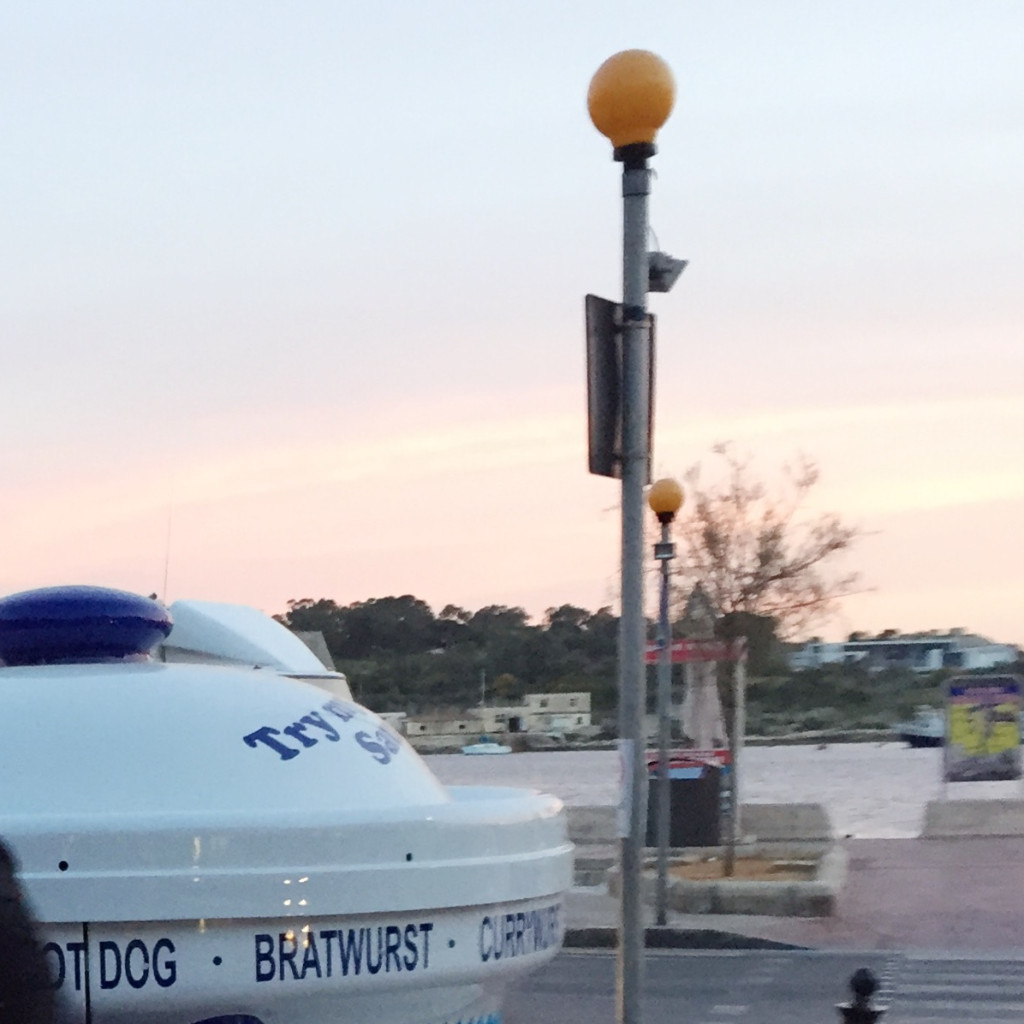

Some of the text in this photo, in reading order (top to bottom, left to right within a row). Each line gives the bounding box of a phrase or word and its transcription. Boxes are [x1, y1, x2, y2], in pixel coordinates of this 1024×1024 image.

[242, 710, 341, 761] Try
[43, 941, 86, 991] OT
[99, 938, 177, 989] DOG
[255, 922, 435, 983] BRATWURST
